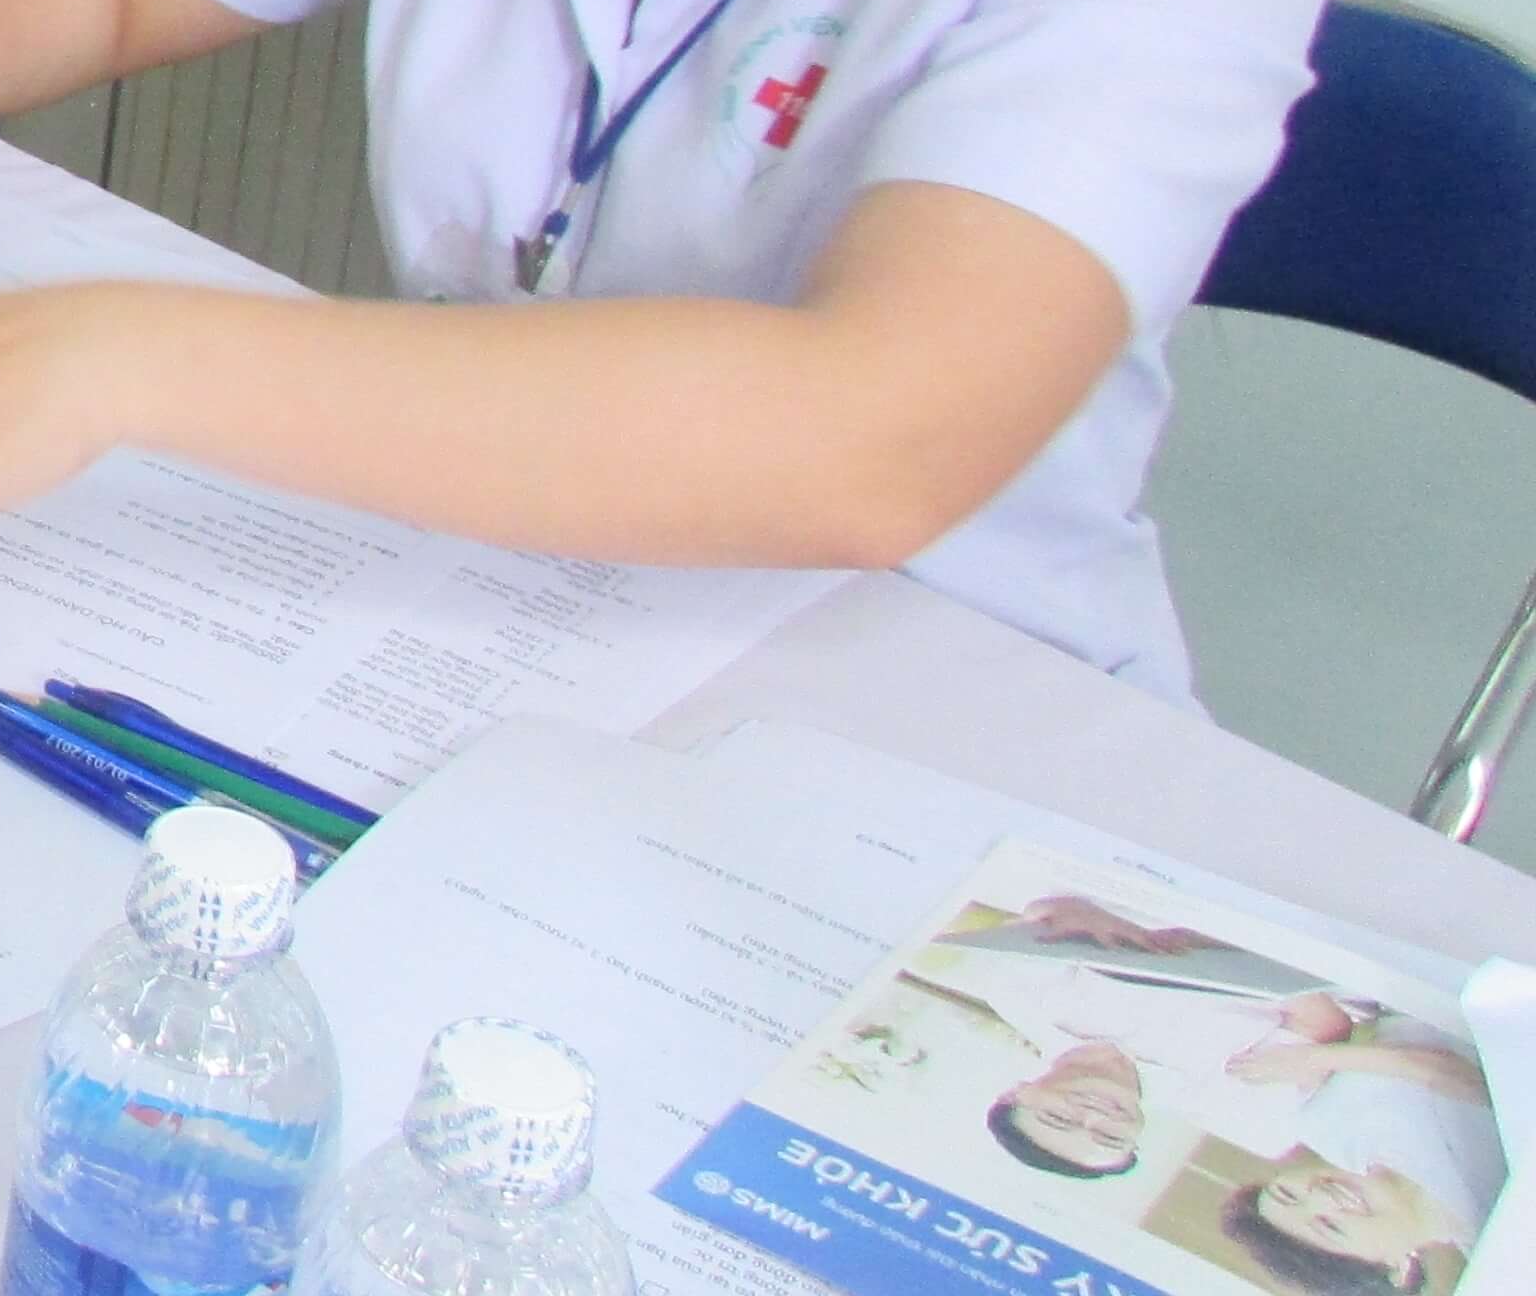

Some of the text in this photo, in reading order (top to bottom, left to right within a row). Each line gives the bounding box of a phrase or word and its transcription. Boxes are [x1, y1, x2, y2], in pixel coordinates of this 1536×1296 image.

[776, 1135, 927, 1222] KHỎE
[728, 1186, 830, 1240] MIMS
[934, 1208, 1048, 1276] SỨC
